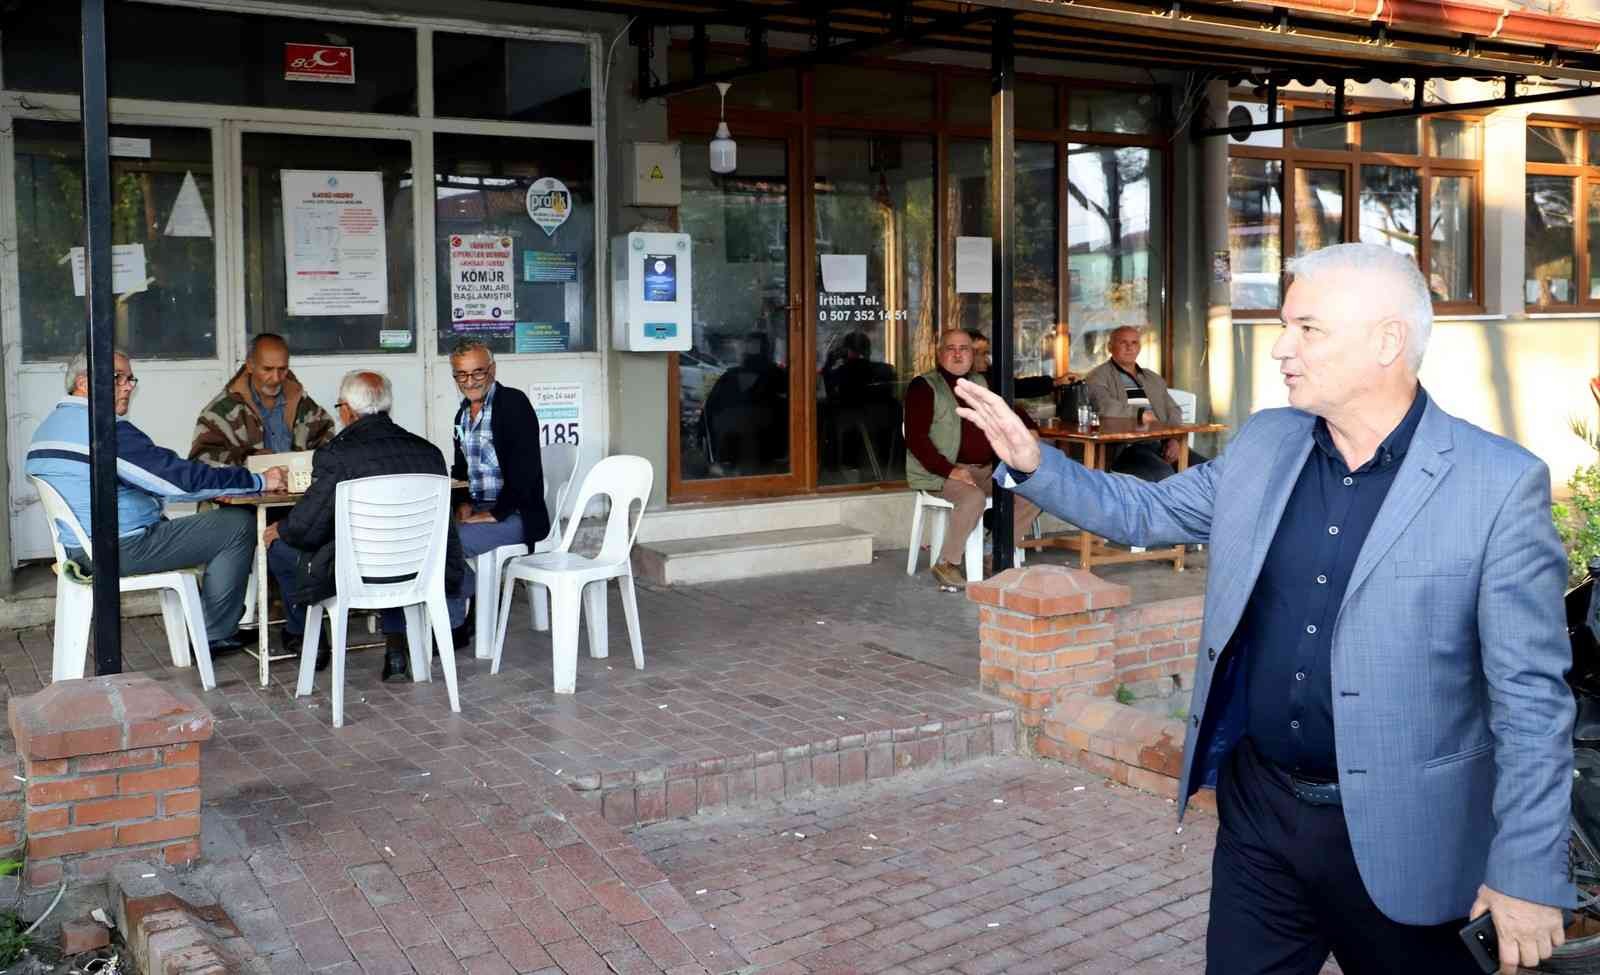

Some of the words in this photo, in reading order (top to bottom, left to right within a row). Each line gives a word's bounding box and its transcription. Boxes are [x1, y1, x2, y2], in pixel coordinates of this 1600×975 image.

[819, 292, 855, 306] İrtibat
[858, 296, 880, 306] Tel.
[819, 310, 827, 322] 0
[830, 310, 851, 322] 507
[854, 309, 875, 321] 352
[895, 309, 908, 321] 51
[541, 422, 579, 447] 185
